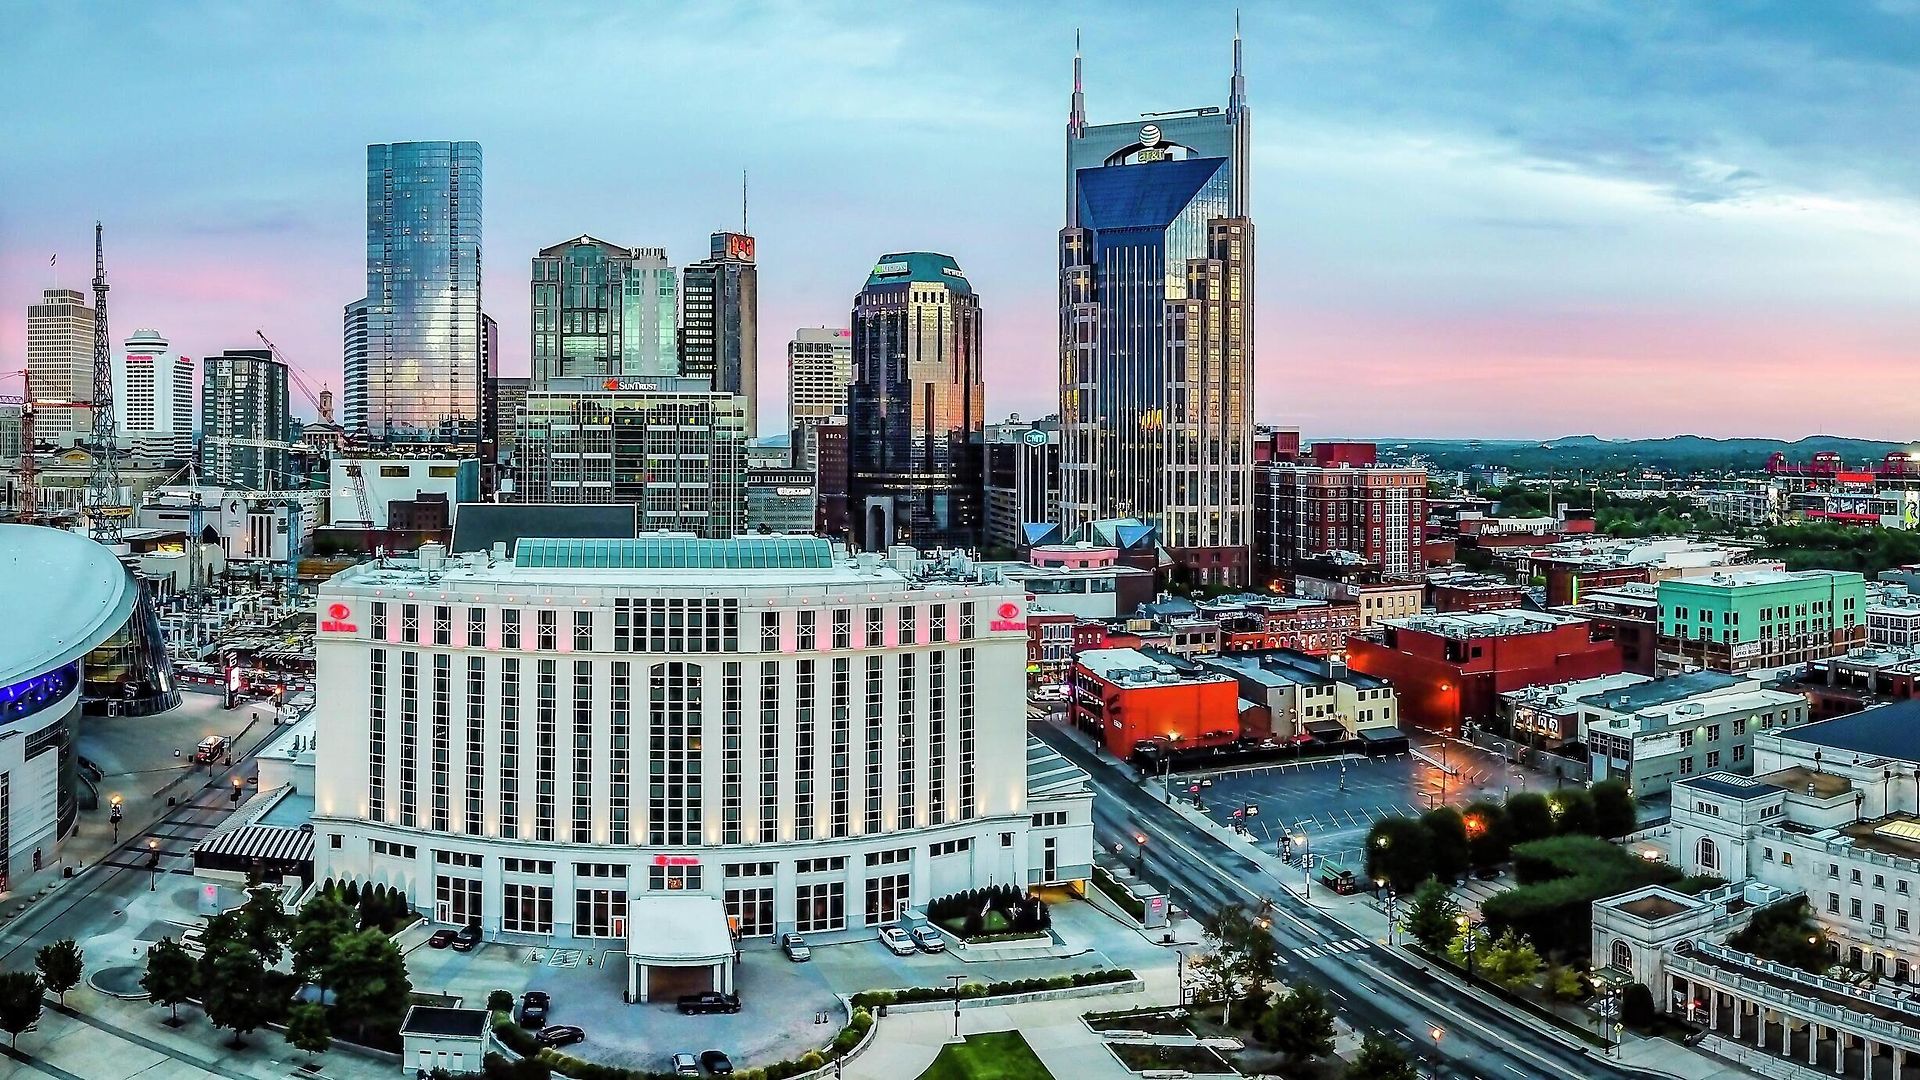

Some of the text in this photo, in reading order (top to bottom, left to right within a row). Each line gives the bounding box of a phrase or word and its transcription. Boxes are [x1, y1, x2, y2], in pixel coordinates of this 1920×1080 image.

[1138, 149, 1164, 162] at&t
[1026, 434, 1043, 443] CMT
[321, 621, 357, 632] Hilton
